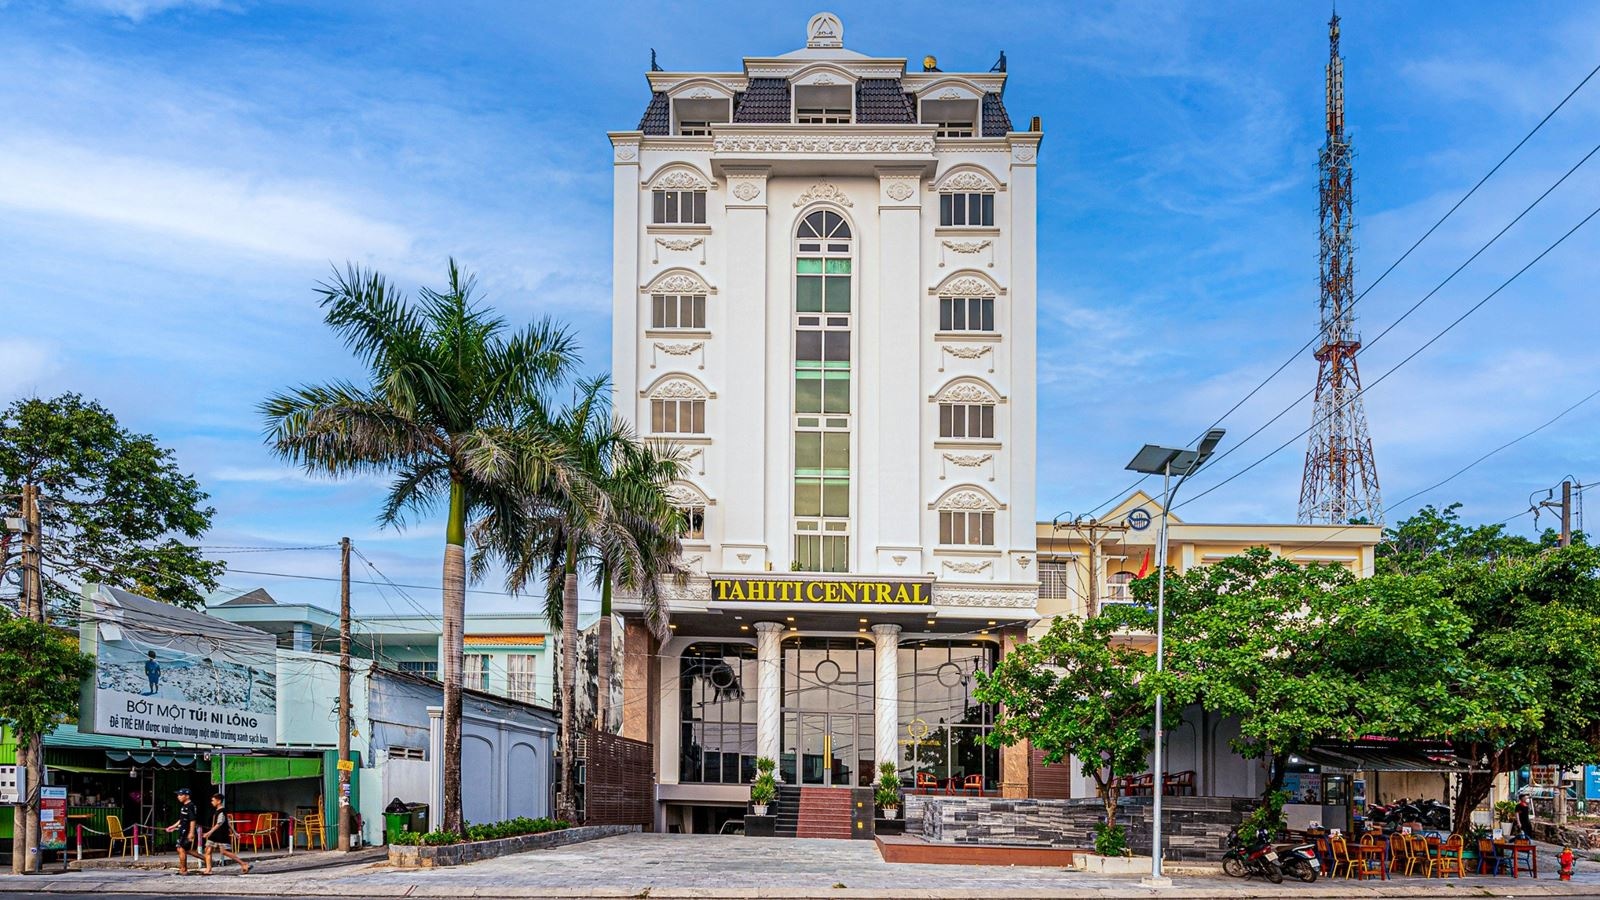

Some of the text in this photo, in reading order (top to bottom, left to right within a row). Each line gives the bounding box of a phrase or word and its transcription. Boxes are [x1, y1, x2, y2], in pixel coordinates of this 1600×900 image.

[715, 580, 929, 603] TAHITI CENTRAL
[127, 699, 258, 728] BỚT MỘT TÚI NI LÔNG
[120, 715, 133, 729] TRẺ
[134, 719, 144, 730] EM
[145, 720, 160, 734] được
[161, 723, 170, 734] vui
[184, 726, 198, 738] trong
